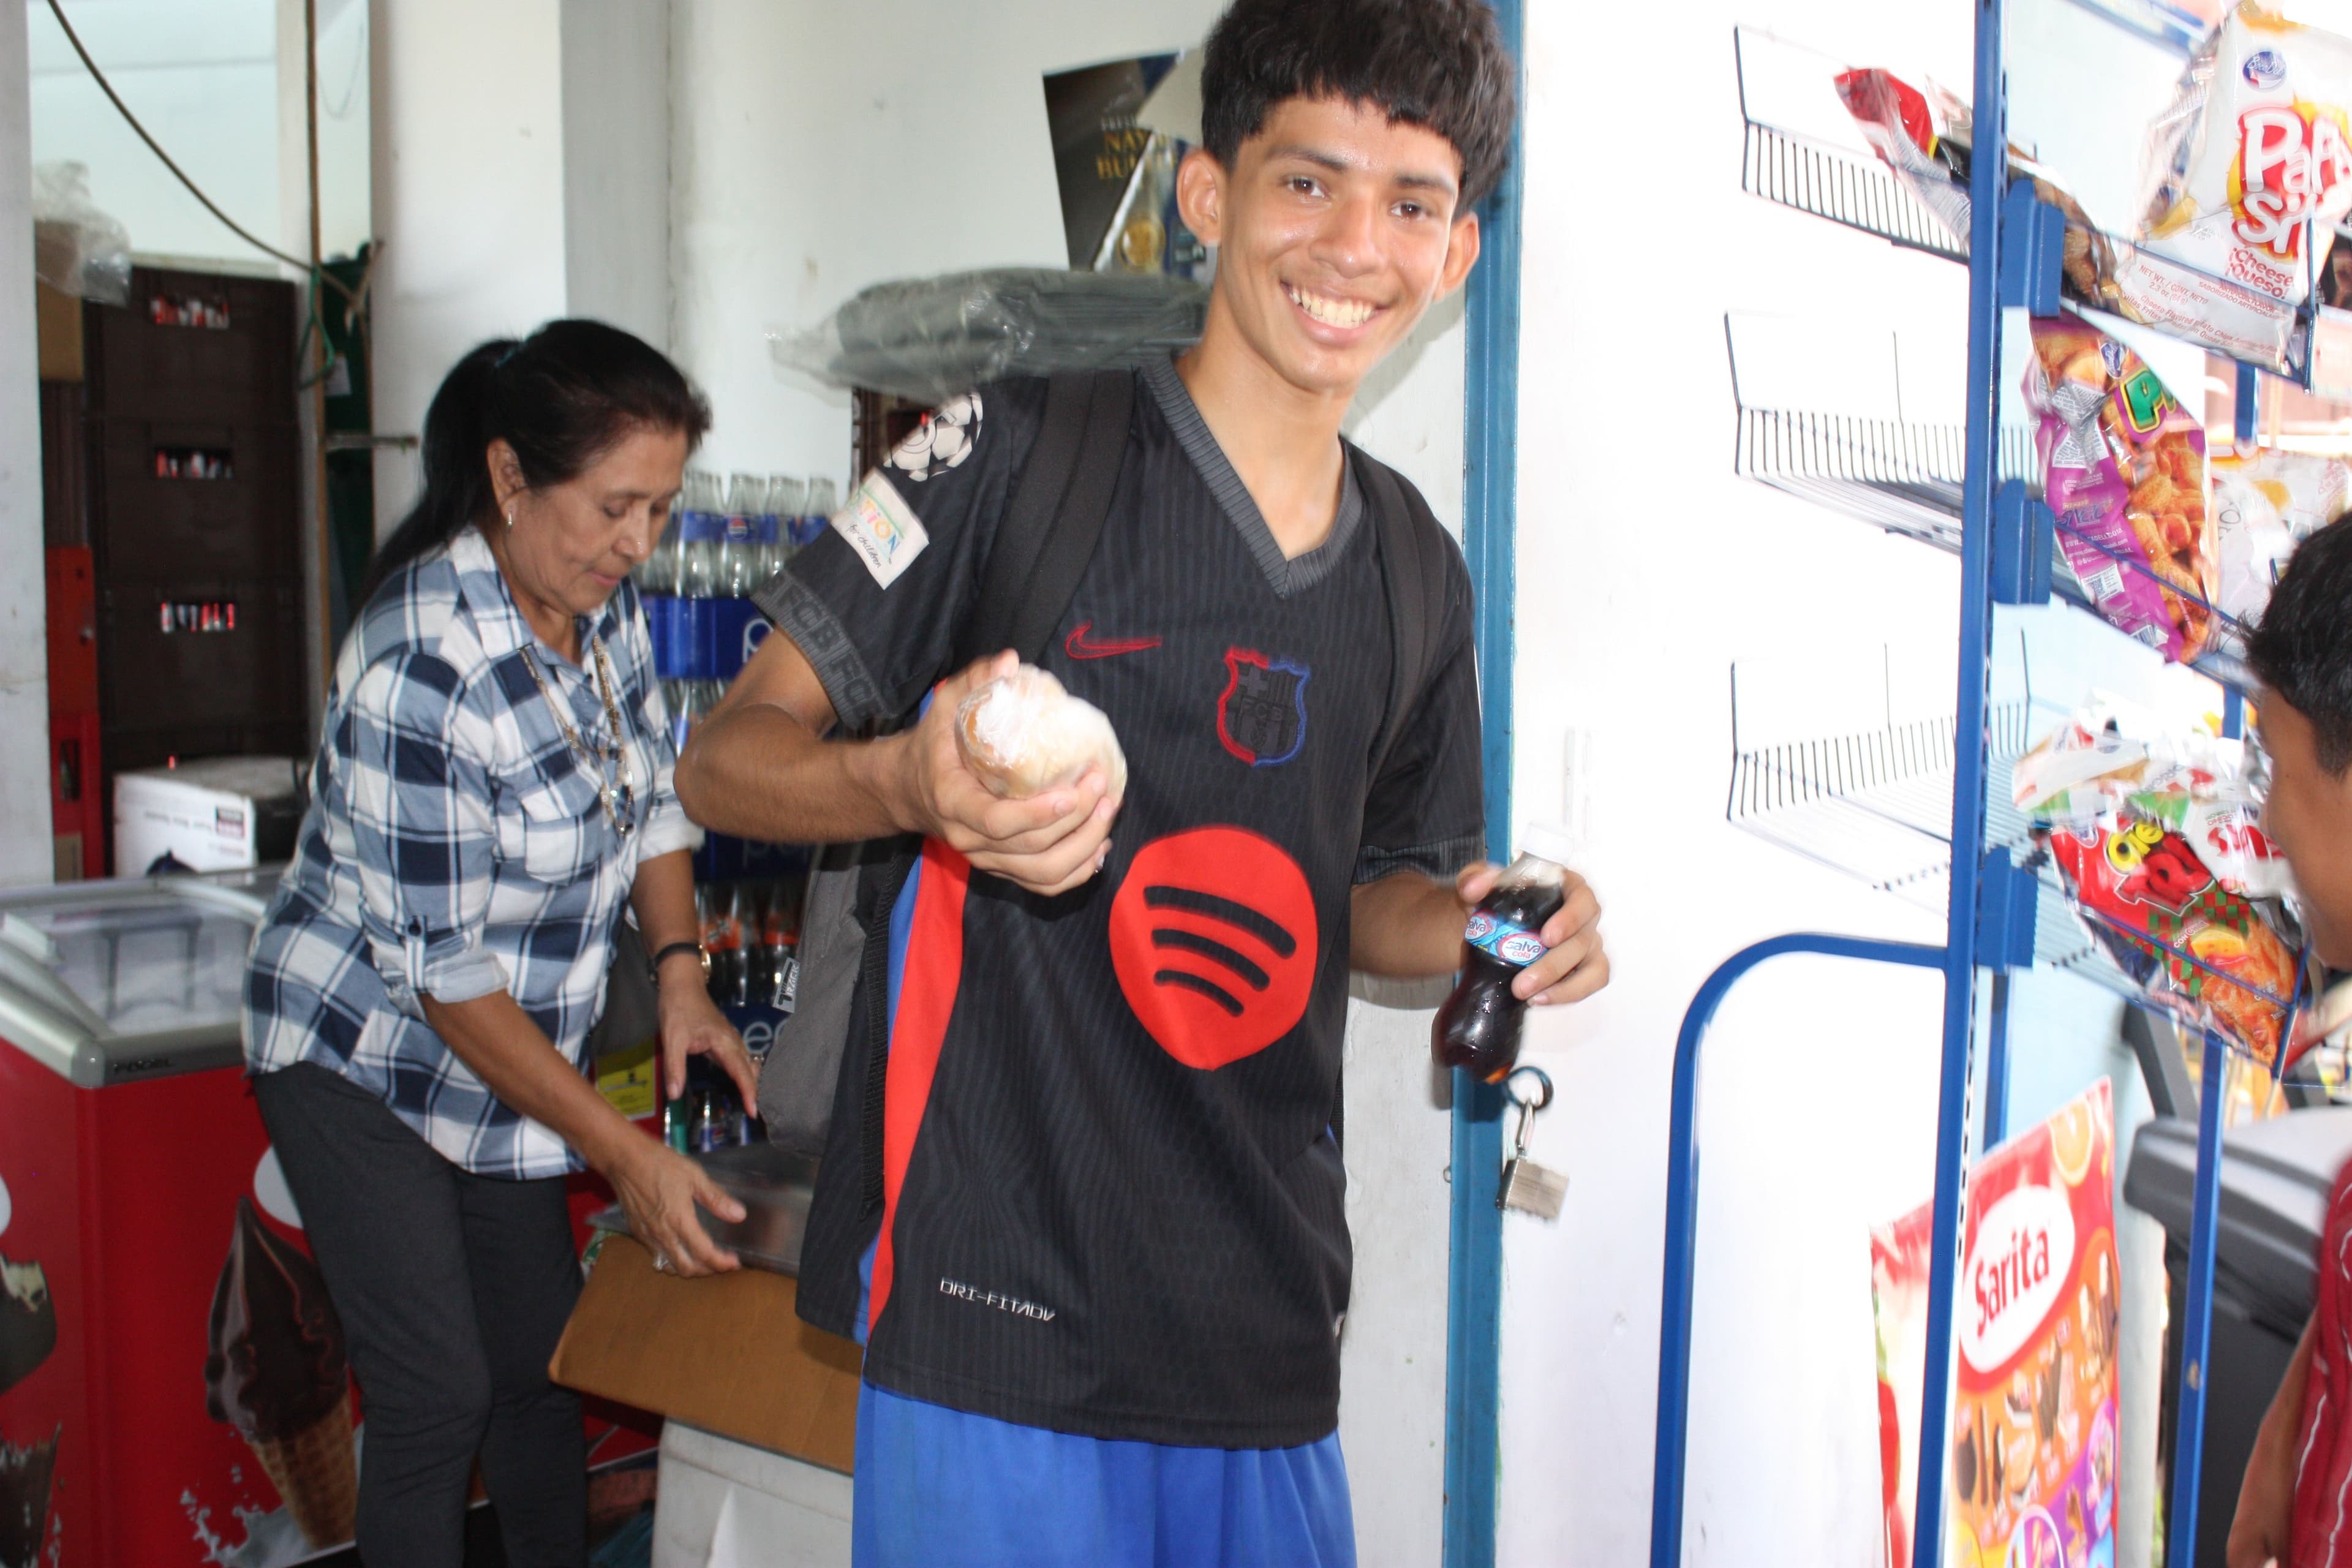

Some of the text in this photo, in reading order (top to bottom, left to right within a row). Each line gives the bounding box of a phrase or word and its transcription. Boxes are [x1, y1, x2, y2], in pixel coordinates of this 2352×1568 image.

[1505, 941, 1542, 954] salva
[1512, 951, 1532, 959] cola
[1975, 1227, 2049, 1339] Sarita
